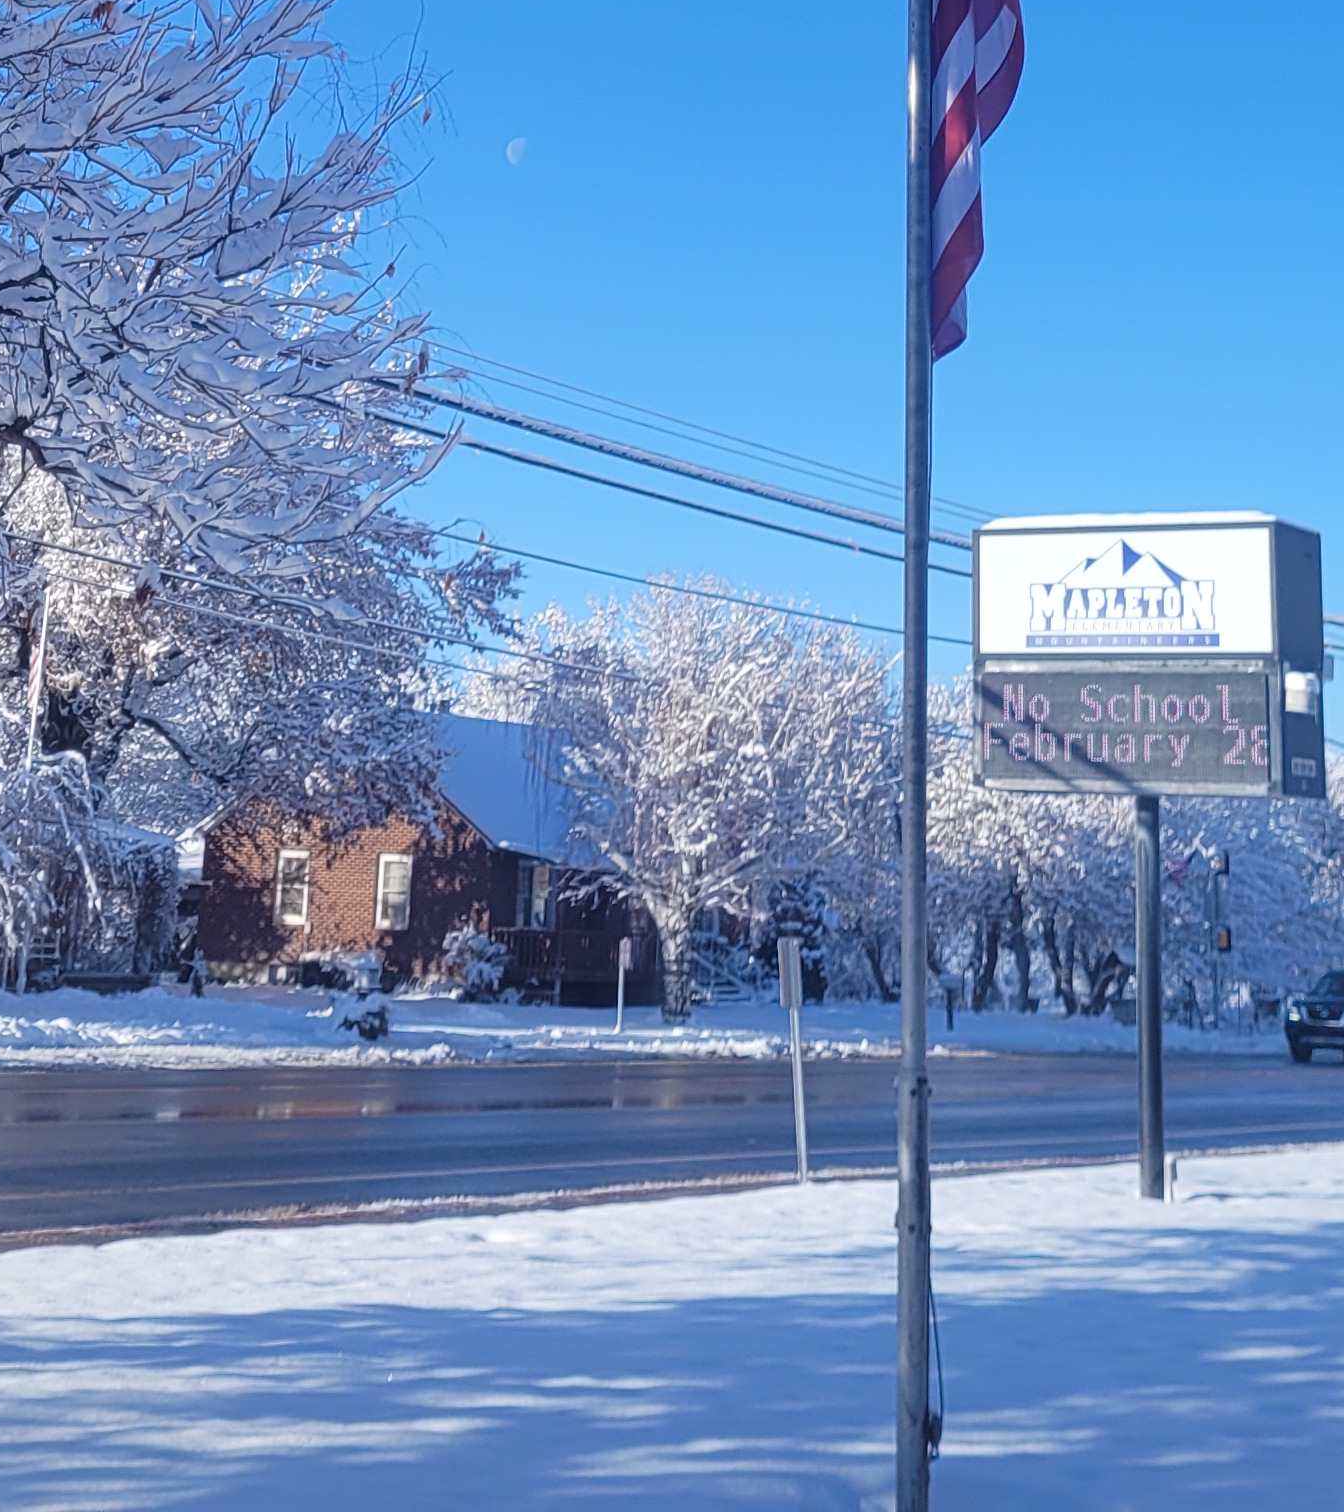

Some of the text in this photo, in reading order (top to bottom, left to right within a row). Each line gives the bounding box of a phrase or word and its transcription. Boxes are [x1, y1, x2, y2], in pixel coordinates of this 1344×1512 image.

[1030, 580, 1215, 632] MAPLETON
[1072, 620, 1175, 632] ELEMENTARY
[1034, 636, 1212, 646] MOUNTAINEERS
[1003, 684, 1239, 724] No School
[983, 722, 1190, 768] February
